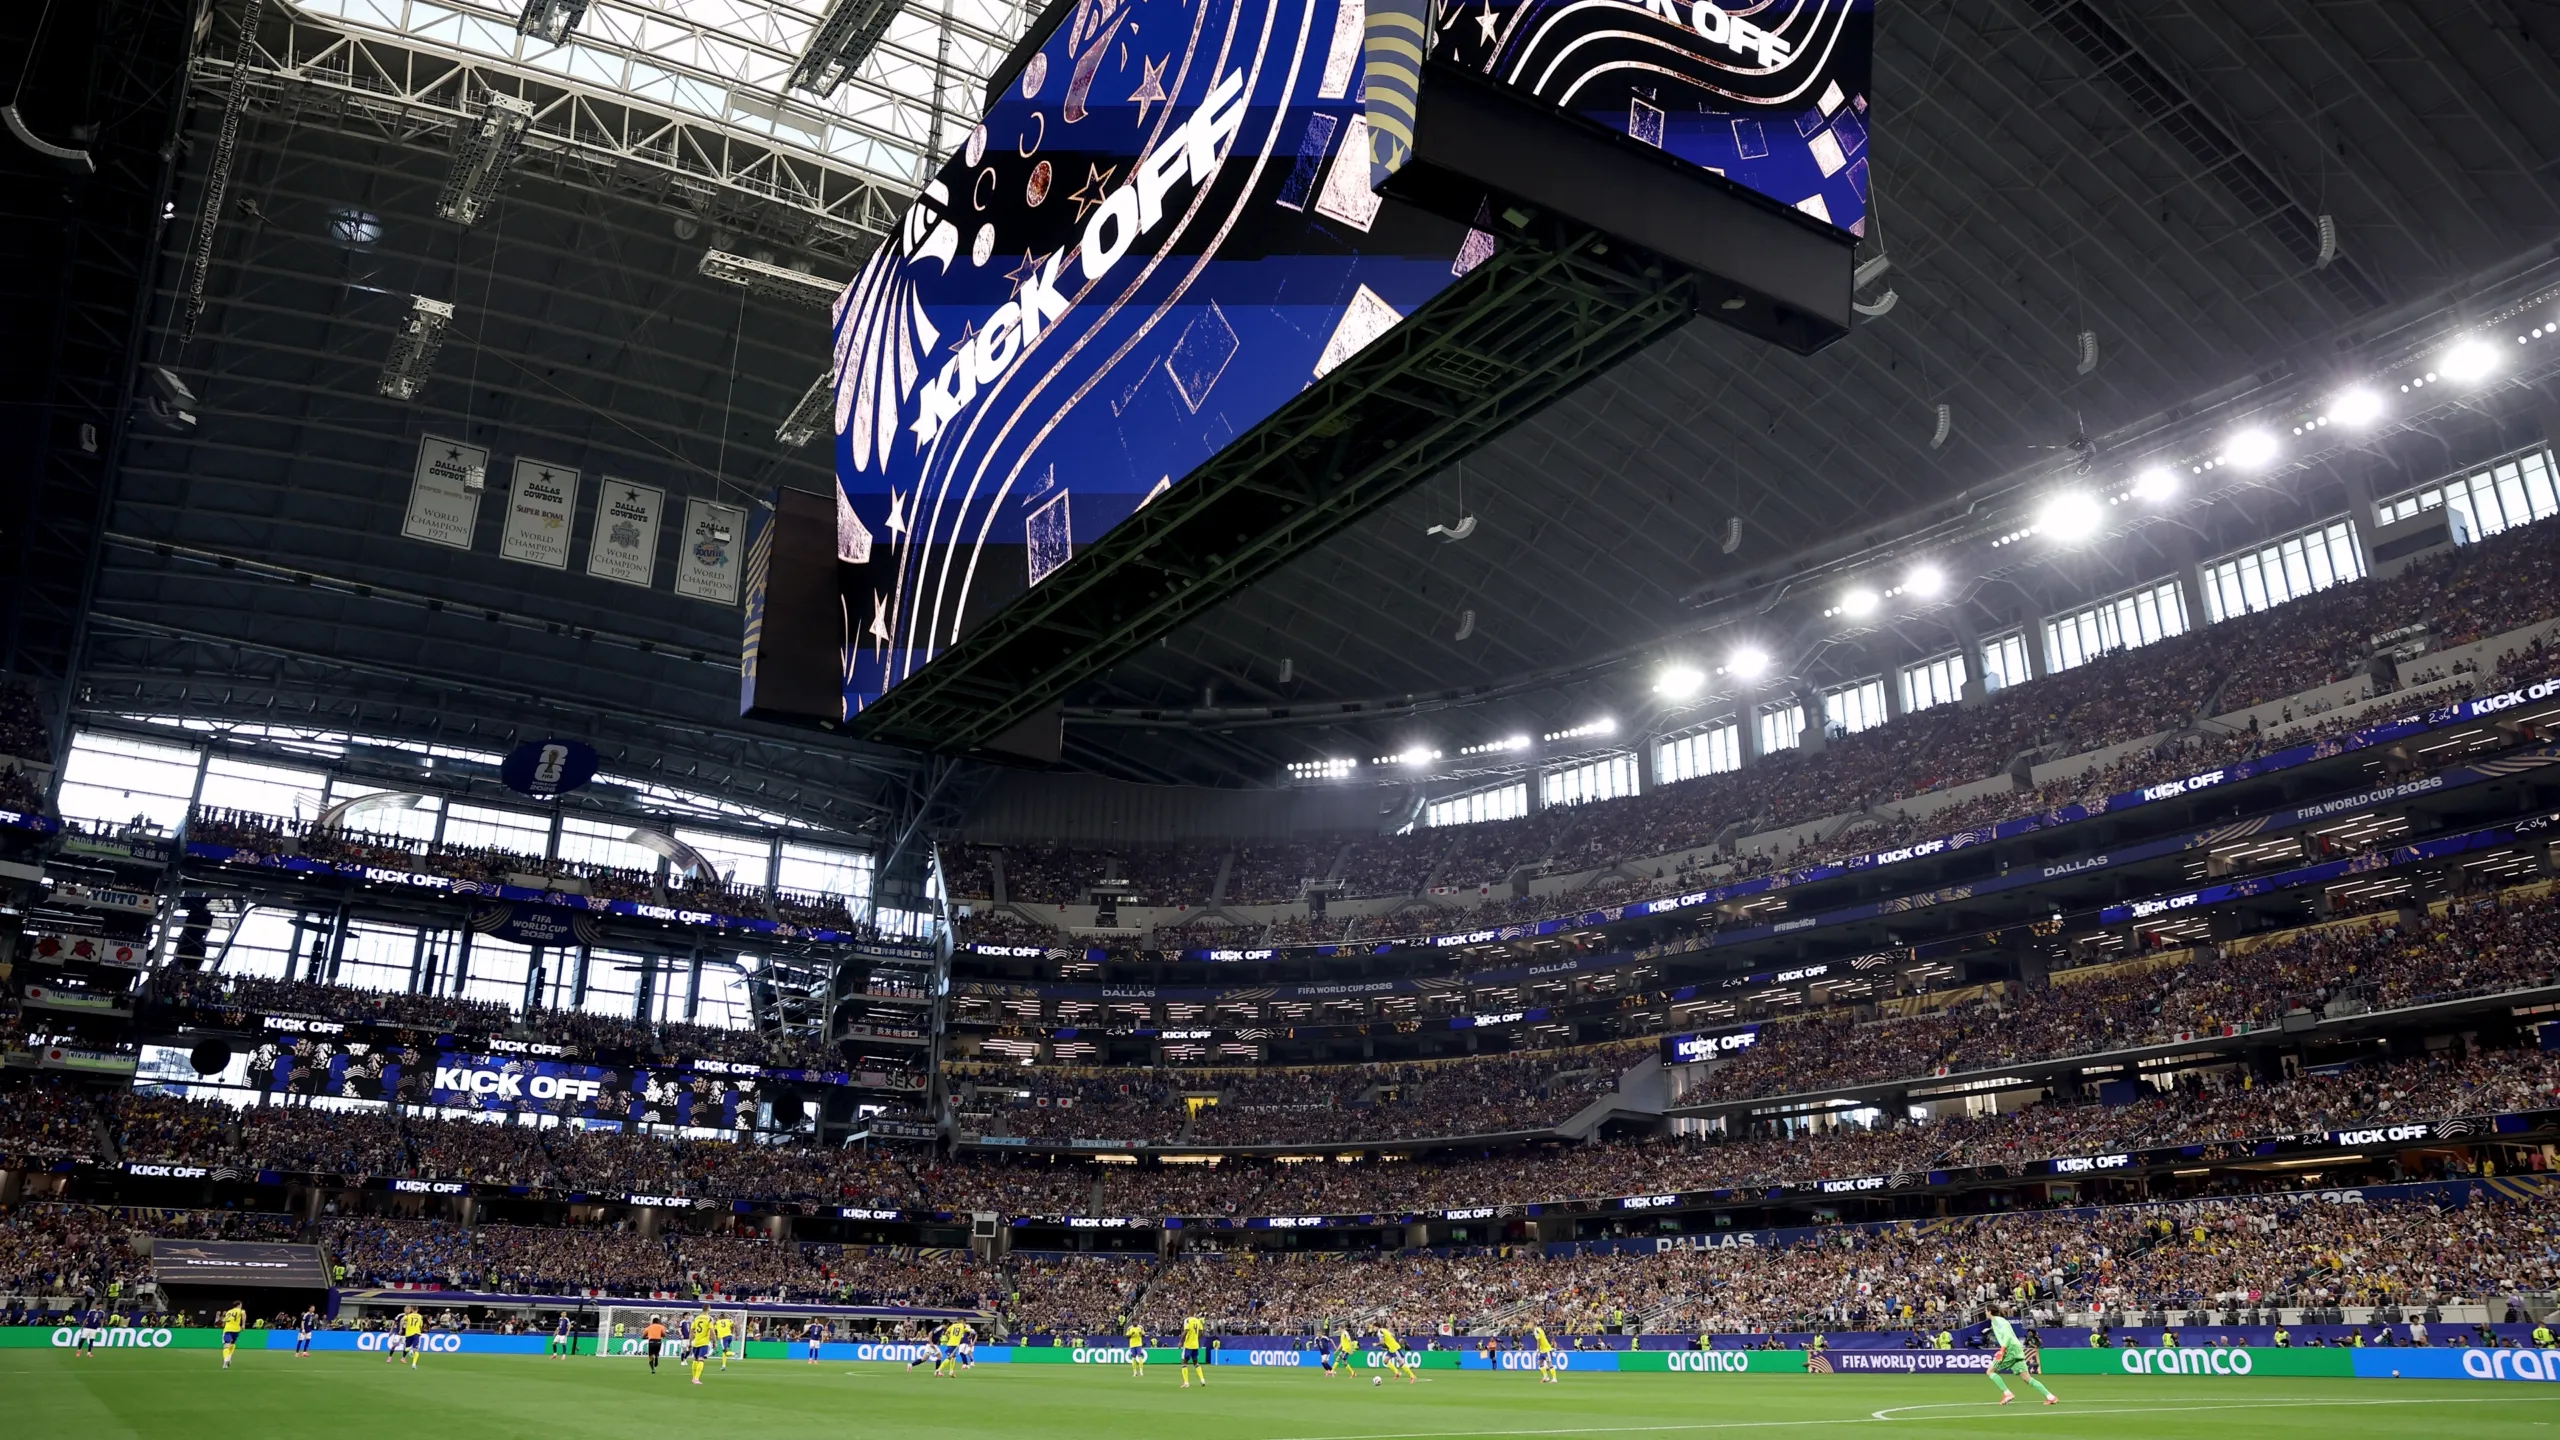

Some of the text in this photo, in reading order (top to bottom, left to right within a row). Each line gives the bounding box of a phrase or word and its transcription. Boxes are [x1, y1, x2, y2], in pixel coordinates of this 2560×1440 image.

[1691, 0, 1790, 69] OFF
[914, 66, 1248, 444] KICK OFF
[529, 483, 561, 495] DALLAS
[523, 490, 564, 504] COWBOYS
[615, 501, 646, 514] DALLAS
[424, 508, 459, 523] WORLD
[610, 508, 648, 523] COWBOYS
[411, 515, 468, 535] CHAMPIONS
[428, 528, 449, 540] 1971
[520, 530, 554, 544] WORLD
[508, 537, 563, 555] CHAMPIONS
[524, 550, 545, 560] 1977
[606, 548, 639, 561] WORLD
[594, 555, 648, 573] CHAMPIONS
[610, 567, 630, 578] 1992
[693, 566, 725, 580] WORLD
[682, 574, 733, 591] CHAMPIONS
[2471, 690, 2527, 716] KICK
[2144, 771, 2223, 800] KICK OFF
[2297, 776, 2443, 820] FIFA WORLD CUP 2026
[1878, 840, 1943, 864] KICK OFF
[2044, 855, 2108, 878] DALLAS
[366, 868, 449, 887] KICK OFF
[92, 889, 138, 906] YUITO
[1649, 893, 1706, 913] KICK OFF
[2136, 894, 2197, 917] KICK OFF
[531, 914, 552, 924] FIFA
[638, 905, 711, 924] KICK OFF
[512, 919, 568, 933] WORLD CUP
[1773, 917, 1816, 933] #FIFAWorldCup
[520, 929, 554, 940] 2026
[1438, 931, 1494, 946] KICK OFF
[978, 946, 1040, 957] KICK OFF
[1211, 950, 1272, 961] KICK OFF
[1529, 960, 1578, 975] DALLAS
[1778, 966, 1827, 981] KICK OFF
[1102, 989, 1156, 998] DALLAS
[1298, 982, 1393, 995] FIFA WORLD CUP 2026
[264, 1017, 344, 1033] KICK OFF
[1477, 1013, 1522, 1025] KICK OFF
[1163, 1031, 1188, 1039] KICK
[489, 1037, 561, 1055] KICK OFF
[1679, 1033, 1754, 1055] KICK OFF
[695, 1060, 760, 1074] KICK OFF
[434, 1067, 600, 1100] KICK OFF
[2339, 1124, 2427, 1145] KICK OFF
[2055, 1152, 2127, 1171] KICK OFF
[131, 1165, 206, 1177] KICK OFF
[396, 1181, 462, 1193] KICK OFF
[1824, 1175, 1883, 1192] KICK OFF
[631, 1196, 690, 1207] KICK OFF
[1625, 1193, 1675, 1207] KICK OFF
[843, 1209, 896, 1219] KICK OFF
[1448, 1209, 1493, 1219] KICK OFF
[1102, 1218, 1125, 1226] OFF
[1270, 1218, 1321, 1227] KICK OFF
[226, 1311, 239, 1323] 24
[410, 1317, 419, 1327] 17
[696, 1321, 704, 1333] 5
[952, 1327, 960, 1337] 18
[1250, 1350, 1300, 1367] aramco
[1667, 1350, 1748, 1373] aramco
[1842, 1355, 1992, 1369] FIFA WORLD CUP 2026
[2121, 1348, 2253, 1375] aramco
